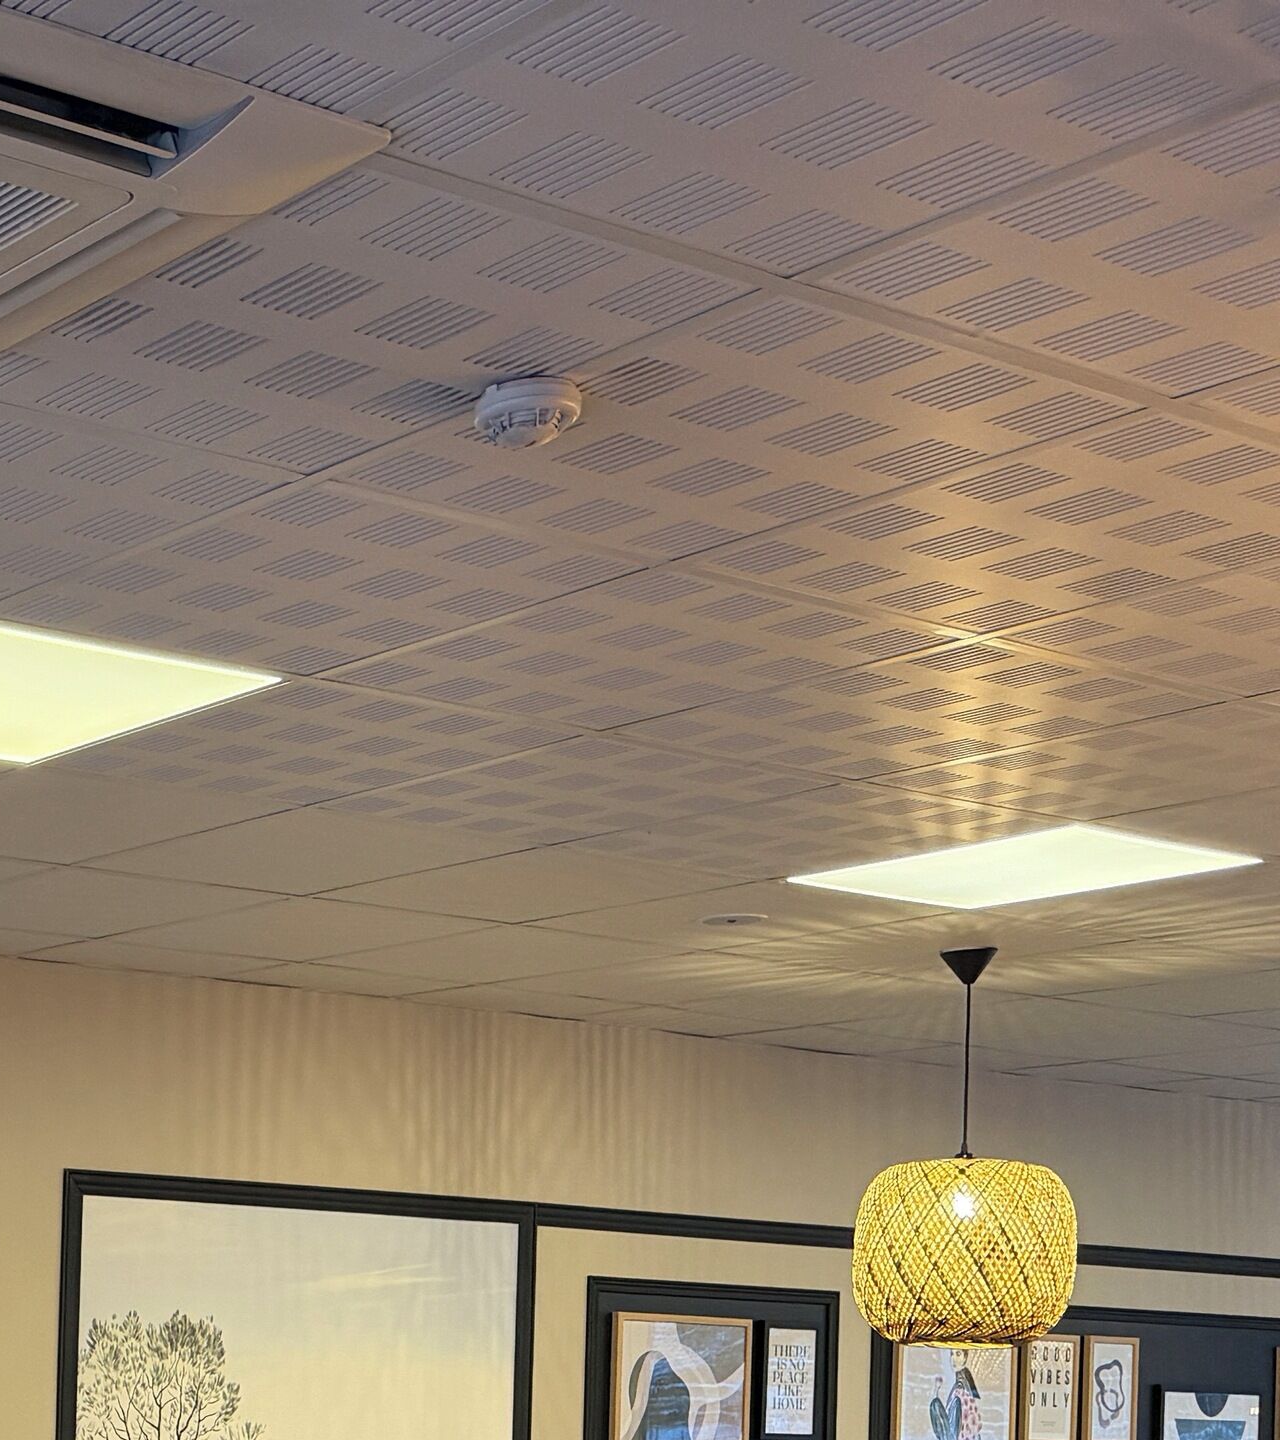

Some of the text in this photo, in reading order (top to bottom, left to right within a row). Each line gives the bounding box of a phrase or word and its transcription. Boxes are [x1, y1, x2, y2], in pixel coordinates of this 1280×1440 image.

[773, 1344, 811, 1357] THERE
[1031, 1346, 1071, 1362] GOOD
[777, 1357, 806, 1371] IS NO
[772, 1370, 808, 1384] PLACE
[1030, 1369, 1070, 1385] VIBES
[777, 1384, 803, 1396] LIKE
[772, 1397, 806, 1410] HOME
[1029, 1391, 1070, 1408] ONLY
